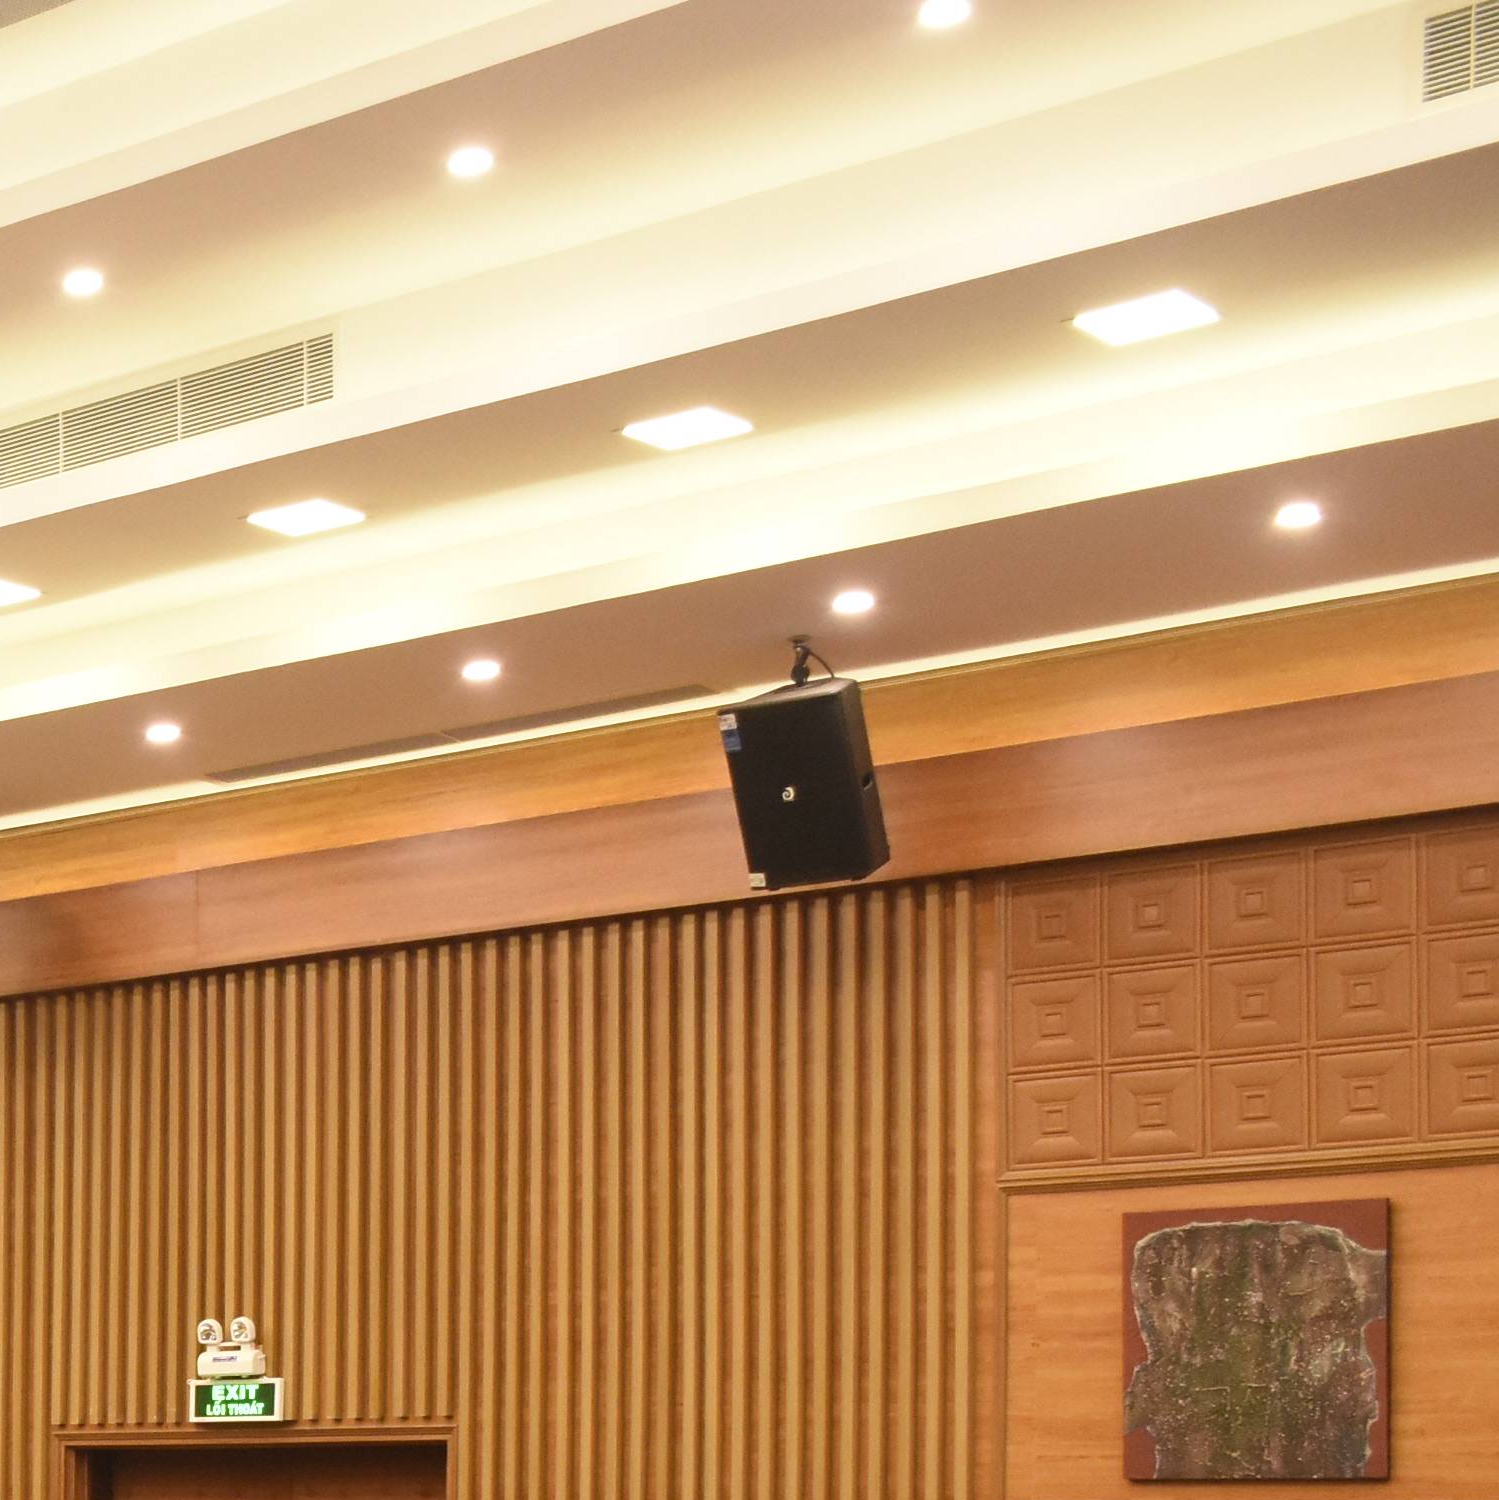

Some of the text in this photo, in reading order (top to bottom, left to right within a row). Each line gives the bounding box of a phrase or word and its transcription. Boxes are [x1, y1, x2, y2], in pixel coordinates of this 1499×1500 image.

[212, 1384, 259, 1400] EXIT
[206, 1400, 264, 1416] LỐI THOÁT
